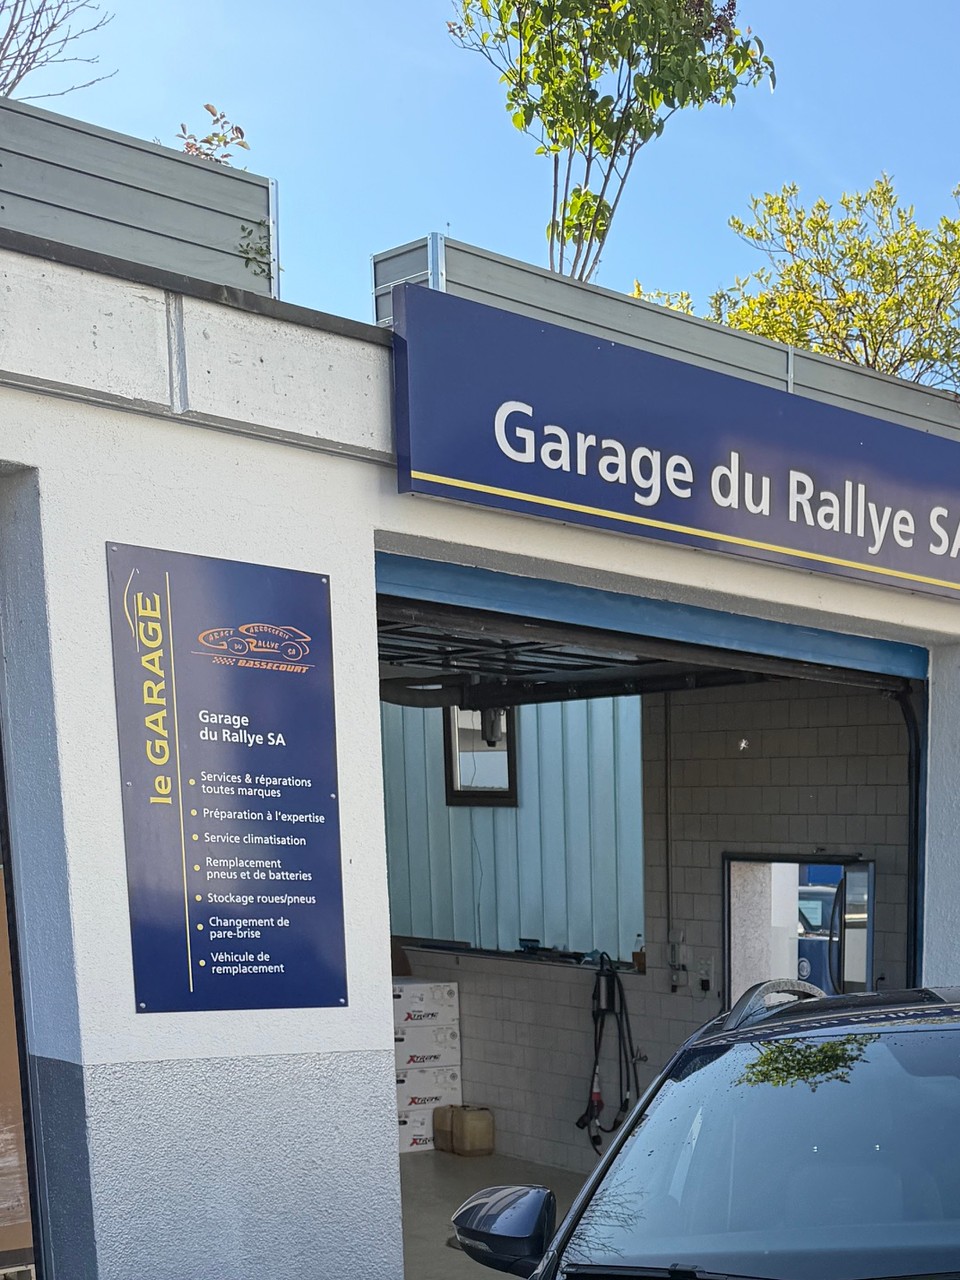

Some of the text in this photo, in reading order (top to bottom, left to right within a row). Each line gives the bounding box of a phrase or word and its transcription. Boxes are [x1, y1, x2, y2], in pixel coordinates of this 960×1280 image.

[494, 400, 694, 506] Garage
[710, 451, 770, 517] du
[789, 469, 915, 555] Rallye
[237, 660, 309, 674] BASSECOURT
[136, 592, 172, 804] le GARAGE
[198, 710, 250, 729] Garage
[199, 727, 287, 747] du Rallye SA
[201, 771, 312, 788] Services & réparations
[202, 784, 282, 799] toutes marques
[203, 808, 264, 821] Préparation
[266, 810, 273, 821] à
[204, 832, 307, 846] Service climatisation
[206, 857, 282, 869] Remplacement
[206, 869, 313, 881] pneus et de batteries
[207, 893, 317, 906] Stockage roues/pneus
[209, 917, 290, 929] Changement de
[209, 927, 261, 940] pare-brise
[210, 952, 270, 962] Véhicule de
[211, 964, 285, 976] remplacement
